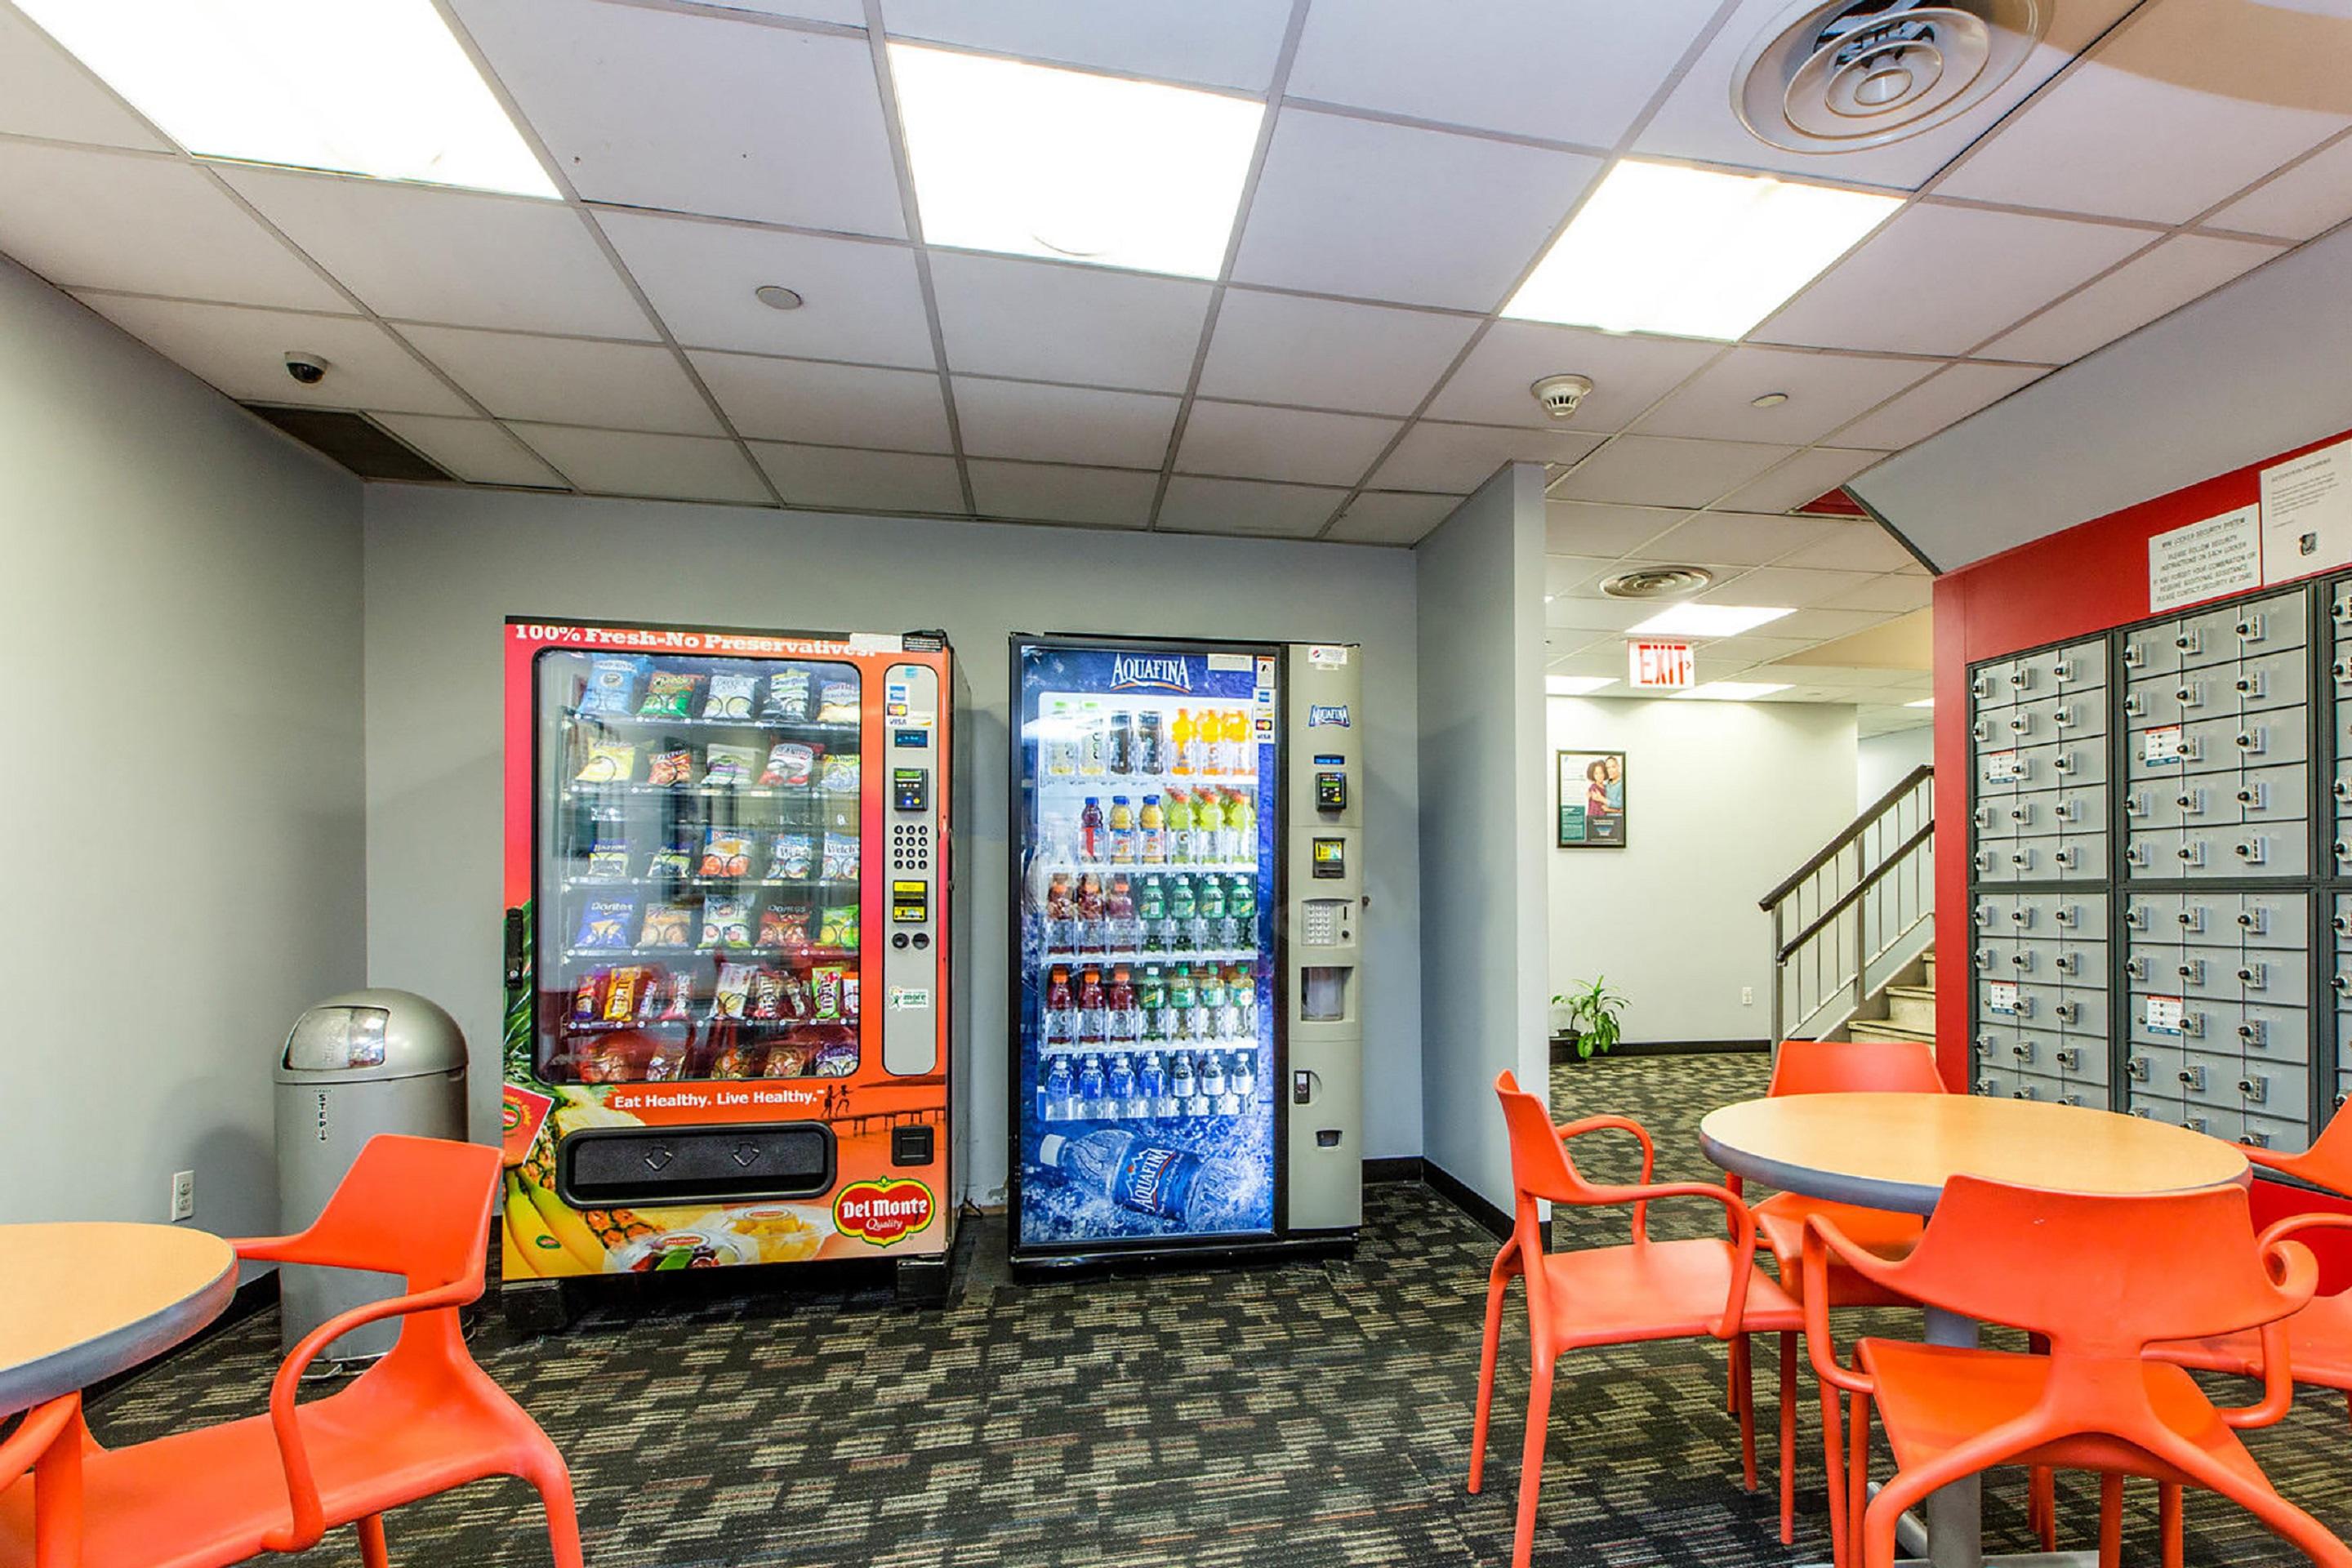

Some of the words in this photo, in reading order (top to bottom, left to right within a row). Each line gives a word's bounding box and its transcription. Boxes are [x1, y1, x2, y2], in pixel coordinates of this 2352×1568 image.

[515, 624, 581, 642] 100%
[585, 628, 699, 648] Fresh-No
[704, 634, 875, 657] Preservative
[1110, 653, 1192, 691] AQUAFINA
[1639, 644, 1686, 684] EXIT
[1310, 706, 1349, 726] AQUAFINA
[591, 902, 634, 911] Doritos
[318, 1094, 327, 1127] STEP
[614, 1095, 641, 1108] Eat
[645, 1092, 712, 1108] Healthy.
[717, 1091, 749, 1105] Live
[1130, 1147, 1175, 1212] AQUAFINA
[842, 1200, 871, 1218] Del
[872, 1197, 928, 1217] Monte
[866, 1218, 903, 1232] Quality
